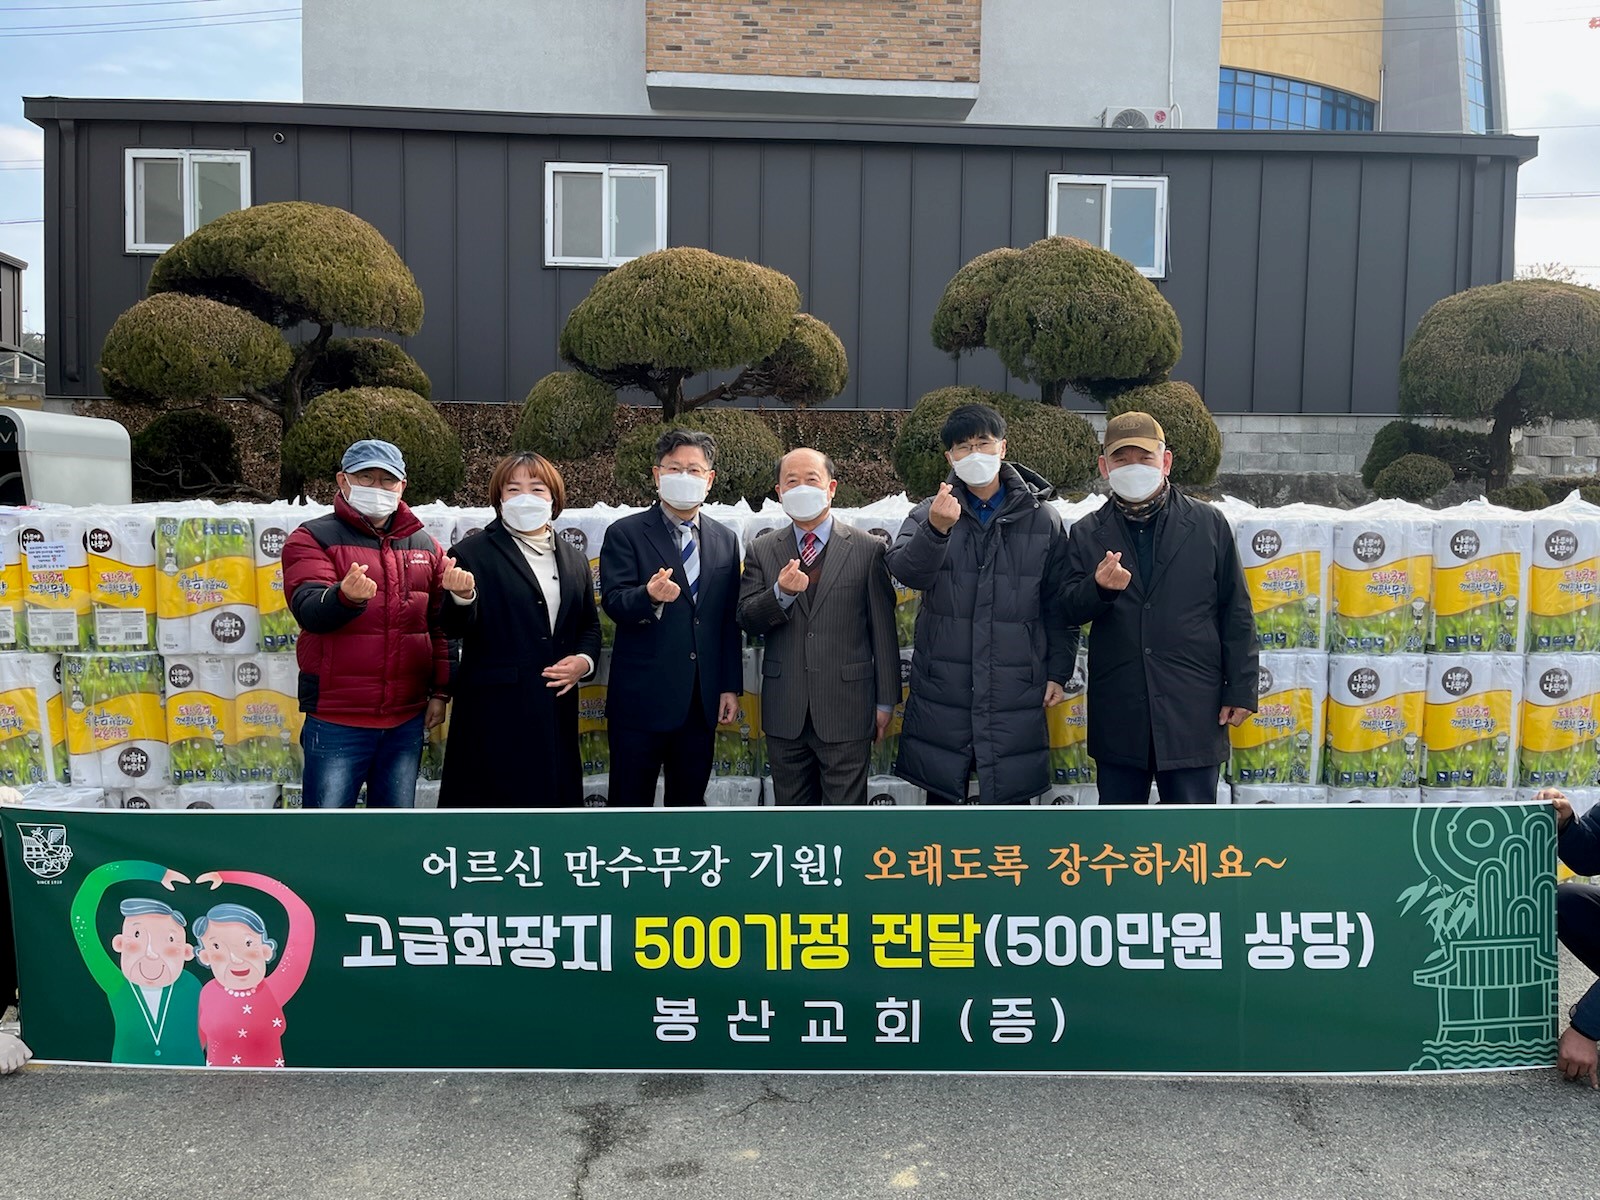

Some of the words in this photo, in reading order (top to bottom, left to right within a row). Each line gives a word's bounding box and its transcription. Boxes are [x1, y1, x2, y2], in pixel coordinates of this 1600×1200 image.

[422, 845, 544, 889] 어르신
[564, 844, 730, 889] 만수무강
[749, 843, 843, 888] 기원!
[865, 843, 1029, 887] 오래도록
[1046, 841, 1287, 887] 장수하세요~
[342, 912, 613, 972] 고급화장지
[634, 912, 850, 971] 500가정
[1244, 910, 1375, 970] 상당)
[959, 996, 1066, 1043] (증)
